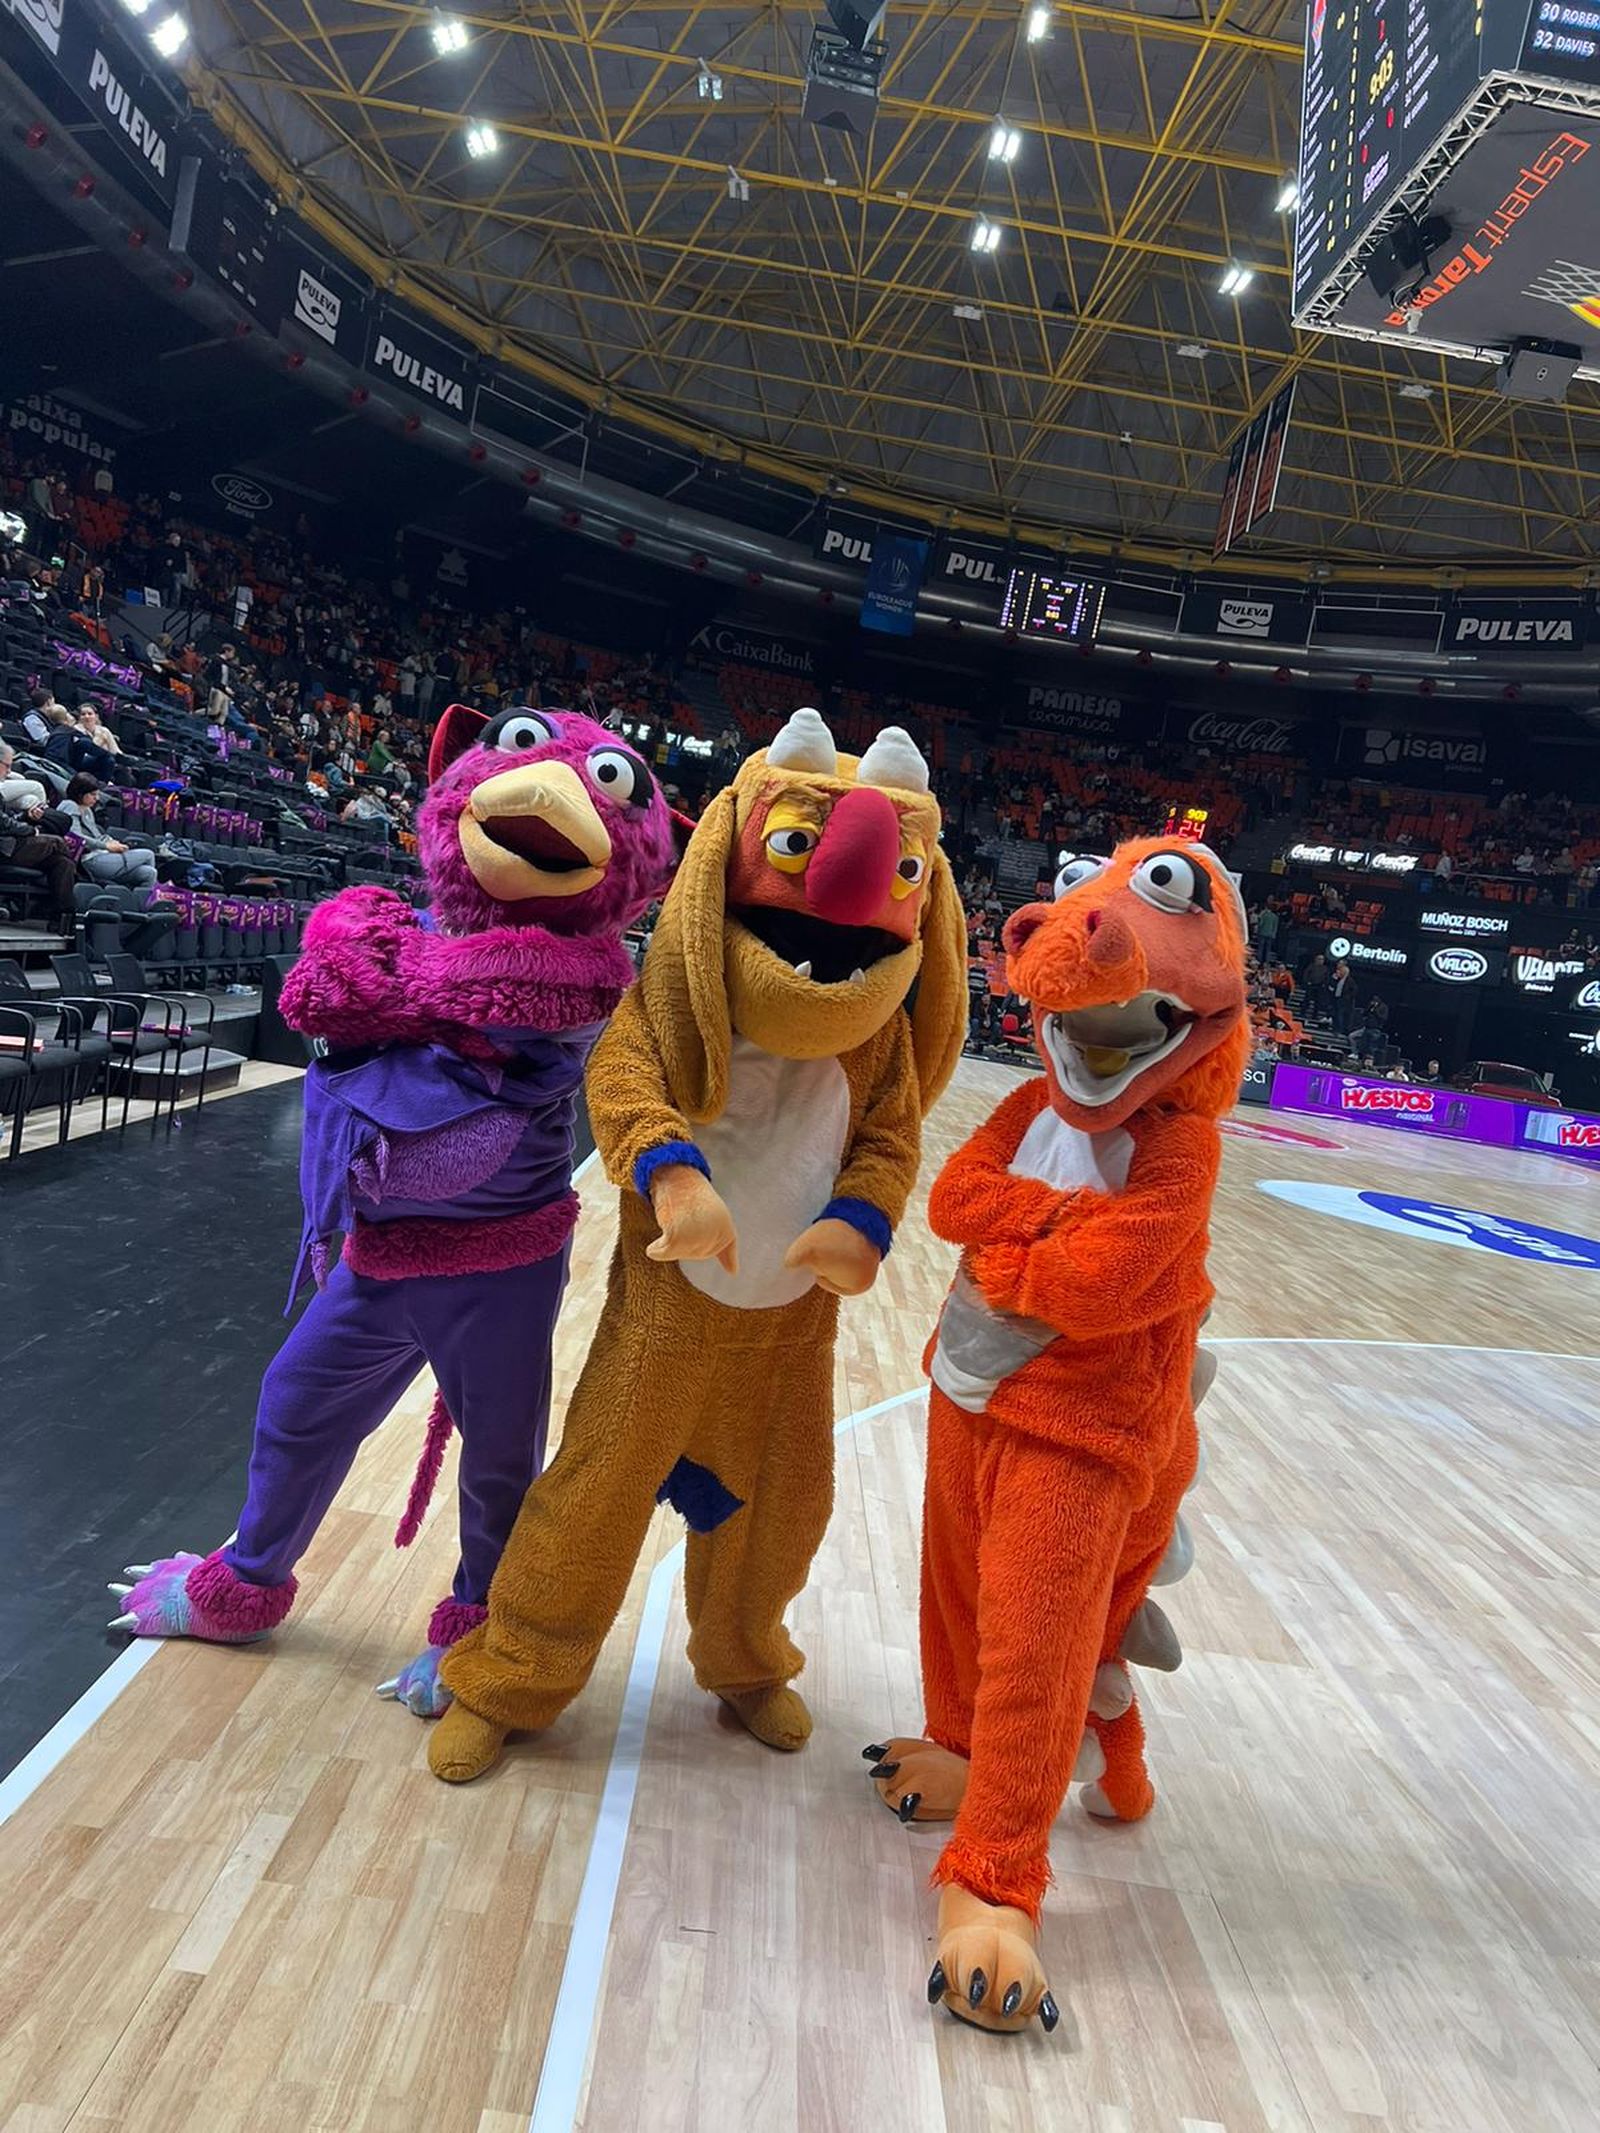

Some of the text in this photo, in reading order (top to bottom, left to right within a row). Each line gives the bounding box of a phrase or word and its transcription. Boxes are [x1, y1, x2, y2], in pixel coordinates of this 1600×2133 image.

[1539, 2, 1600, 30] 30 ROBER
[1533, 29, 1596, 57] 32 DAVIES
[1369, 49, 1394, 105] 9:03
[88, 48, 166, 178] PULEVA
[1475, 132, 1592, 249] Esperit
[301, 278, 338, 317] PULEVA
[1383, 243, 1494, 327] Tarona
[374, 335, 464, 411] PULEVA
[15, 394, 83, 430] aixa
[9, 408, 117, 464] popular
[223, 479, 263, 505] Ford
[946, 552, 998, 583] PUL
[1223, 603, 1269, 618] PULEVA
[1455, 617, 1573, 641] PULEVA
[715, 630, 814, 672] CaixaBank
[1028, 687, 1121, 719] PAMESA
[1188, 712, 1295, 752] Coca-Cola
[1402, 733, 1488, 763] isaval
[1178, 818, 1206, 840] 24
[1421, 912, 1509, 932] MUÑOZ BOSCH
[1352, 942, 1407, 964] Bertolín
[1437, 956, 1481, 973] VALOR
[1342, 1087, 1434, 1112] HUESITOS
[1560, 1124, 1600, 1146] HUE
